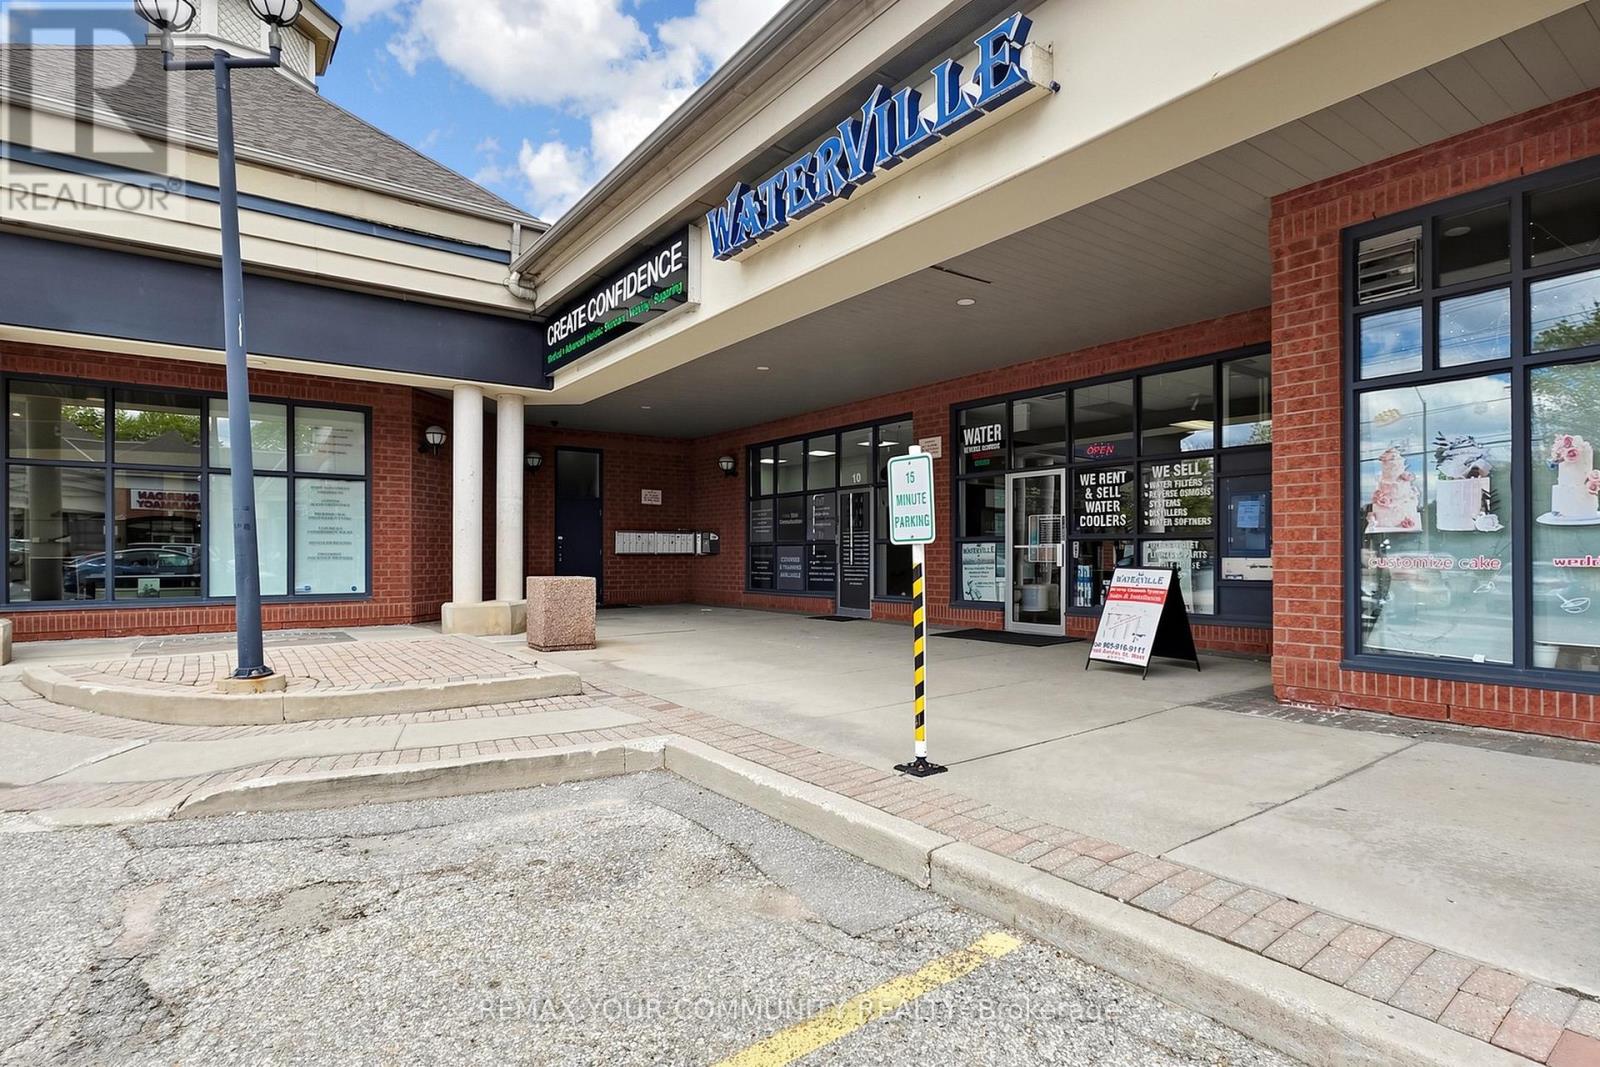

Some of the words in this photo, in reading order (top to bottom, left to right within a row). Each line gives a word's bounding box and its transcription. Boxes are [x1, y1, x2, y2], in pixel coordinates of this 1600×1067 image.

[705, 11, 1036, 262] WATERVILLE
[547, 305, 586, 346] CREATE
[588, 241, 682, 321] CONFIDENCE
[963, 423, 1002, 446] WATER
[1086, 445, 1115, 456] OPEN
[1151, 464, 1171, 479] WE
[1173, 461, 1202, 477] SELL
[852, 472, 862, 484] 10
[905, 471, 916, 484] 15
[1079, 473, 1096, 486] WE
[1099, 470, 1127, 485] RENT
[1149, 480, 1173, 489] WATER
[1174, 478, 1203, 488] FILTERS
[896, 491, 927, 506] MINUTE
[1084, 487, 1093, 500] &
[1096, 485, 1121, 499] SELL
[1179, 487, 1212, 497] OSMOSIS
[1085, 500, 1121, 514] WATER
[1149, 499, 1182, 508] SYSTEMS
[1149, 508, 1188, 517] DISTILLERS
[894, 514, 930, 529] PARKING
[1079, 514, 1127, 527] COOLERS
[1149, 519, 1173, 527] WATER
[1368, 557, 1453, 570] customize
[1458, 556, 1502, 570] cake
[1116, 575, 1164, 585] WATERVILLE
